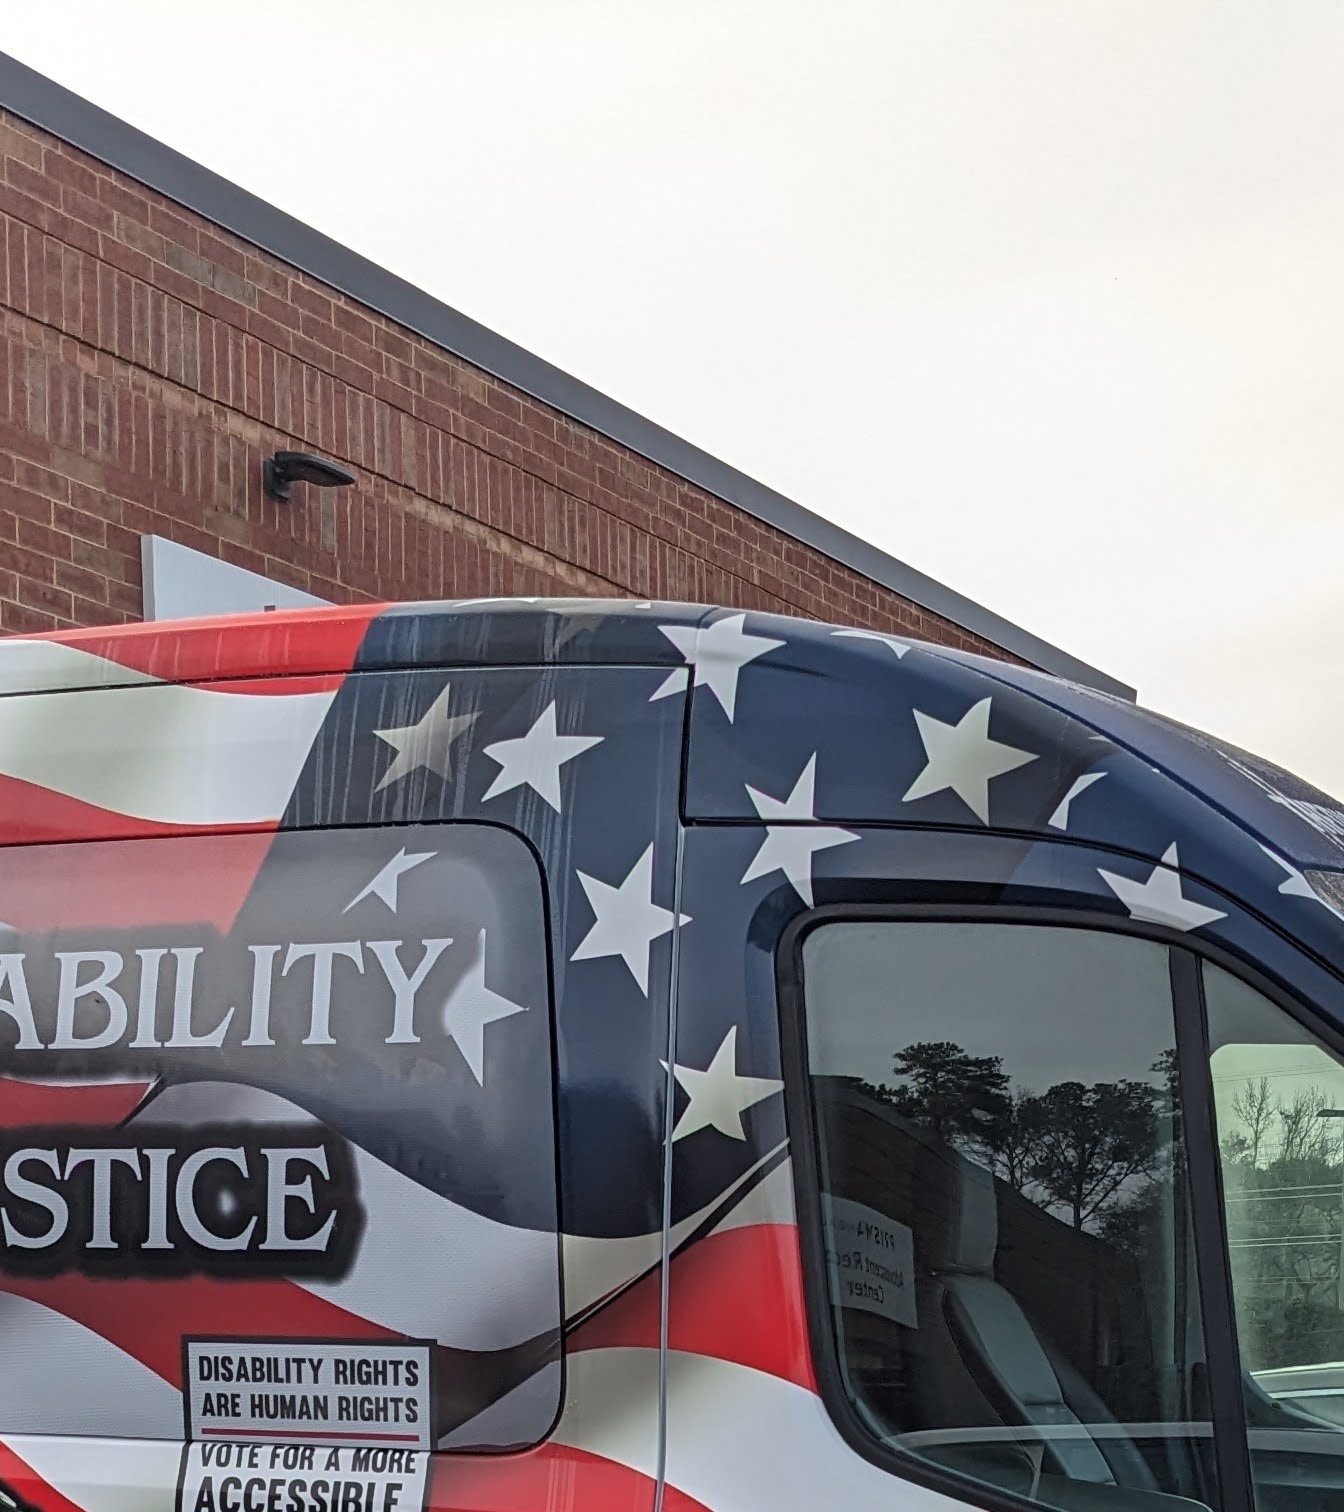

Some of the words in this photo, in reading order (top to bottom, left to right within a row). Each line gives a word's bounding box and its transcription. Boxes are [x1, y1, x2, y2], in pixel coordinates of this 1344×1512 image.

[199, 1356, 323, 1384] DISABILITY
[334, 1358, 418, 1386] RIGHTS
[202, 1393, 241, 1417] ARE
[251, 1394, 328, 1420] HUMAN
[338, 1396, 418, 1423] RIGHTS
[201, 1443, 261, 1469] VOTE
[269, 1445, 314, 1471] FOR
[325, 1446, 340, 1472] A
[351, 1448, 417, 1474] MORE
